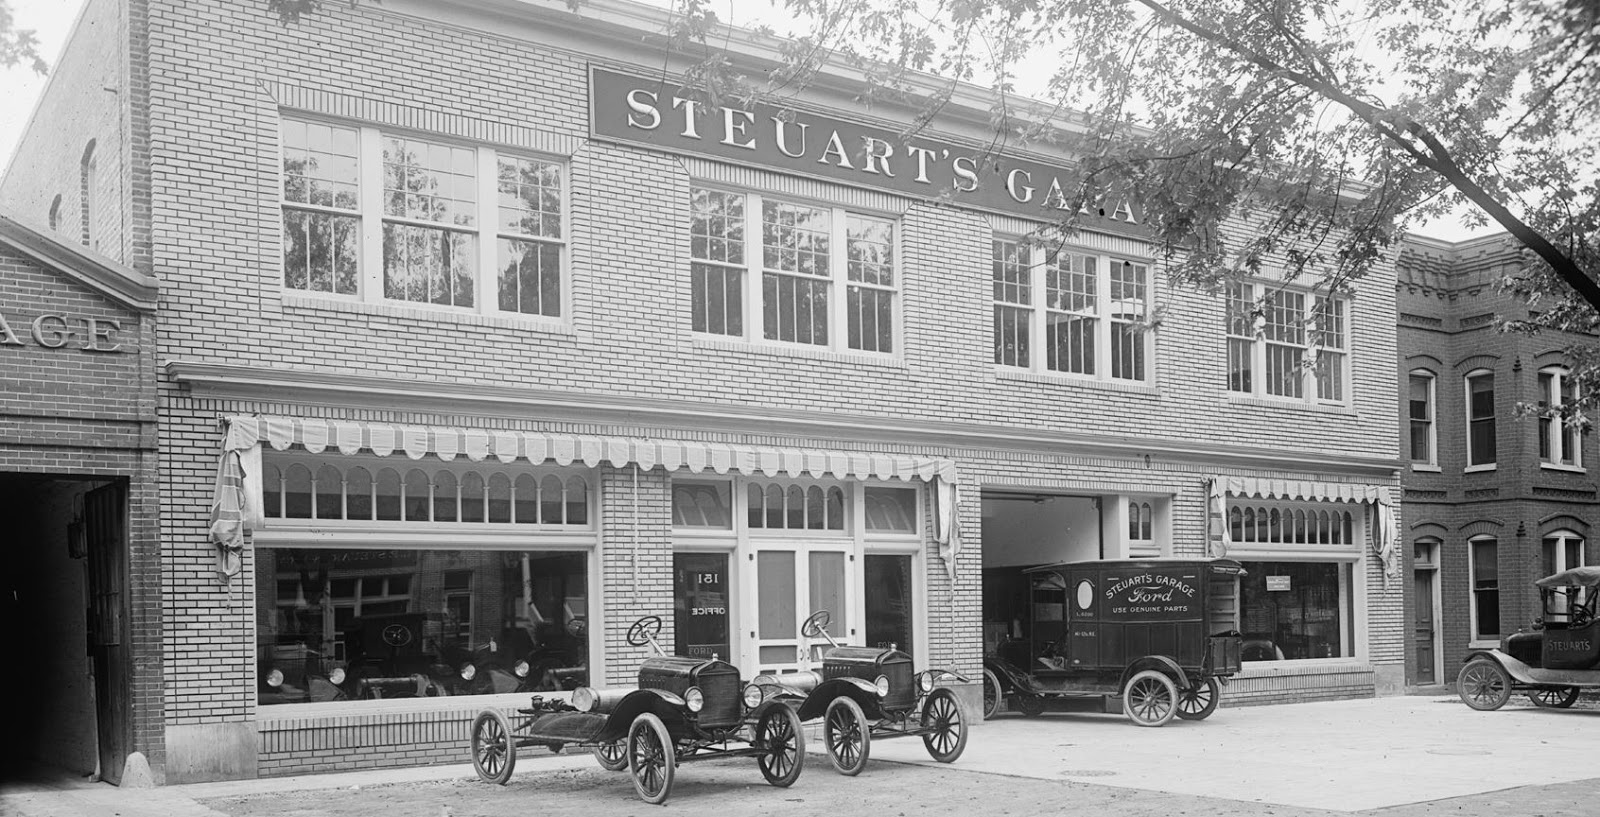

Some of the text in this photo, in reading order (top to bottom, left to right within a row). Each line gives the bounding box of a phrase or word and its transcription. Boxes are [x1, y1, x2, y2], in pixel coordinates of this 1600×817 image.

[626, 89, 1152, 225] STEUART'S GAA
[1105, 572, 1196, 600] STEUART'S GARAGE
[1128, 585, 1175, 604] Ford
[1112, 606, 1127, 614] USE
[688, 646, 713, 655] FORD
